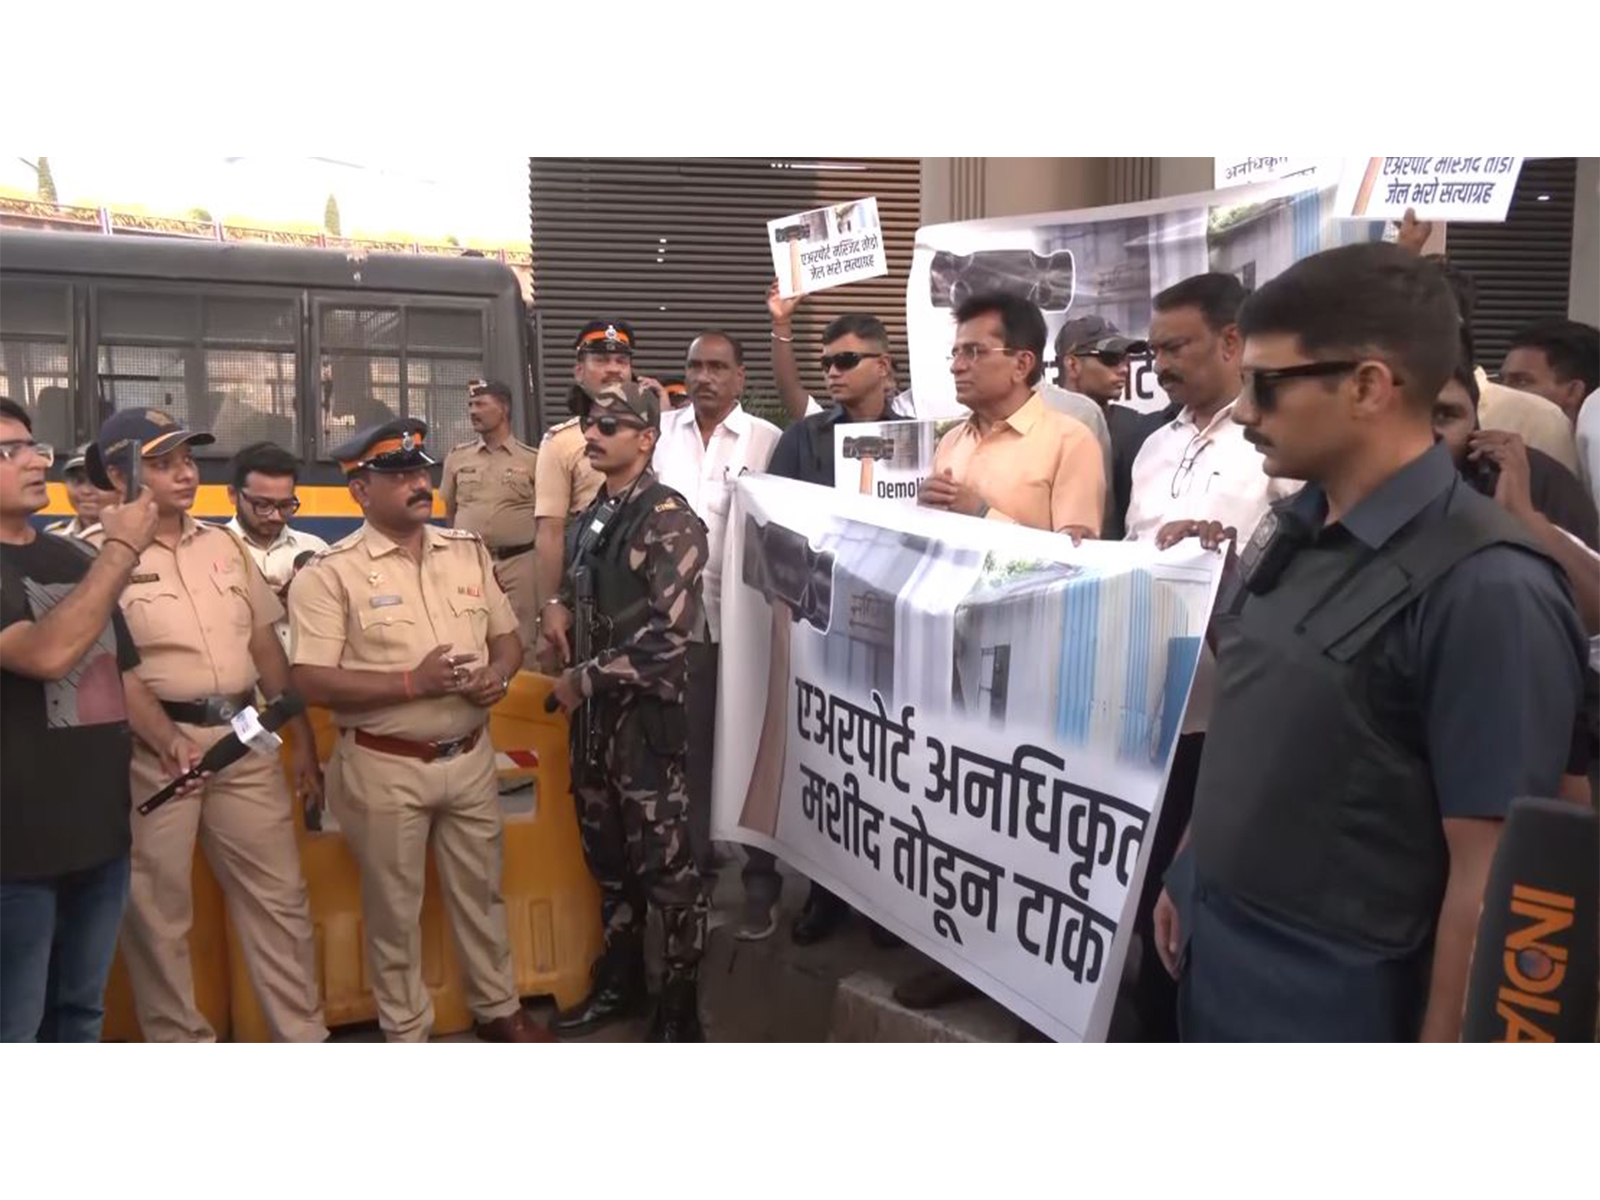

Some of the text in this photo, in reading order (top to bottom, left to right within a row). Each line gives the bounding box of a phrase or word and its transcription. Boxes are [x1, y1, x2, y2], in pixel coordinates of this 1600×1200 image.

[1385, 177, 1496, 205] जेल भरो सत्याग्रह
[809, 254, 875, 280] जेल भरो सत्याग्रह
[877, 477, 923, 499] Demol
[795, 677, 1151, 900] एअरपोर्ट अनधिकृत
[799, 764, 1118, 985] मशीद तोडून टाक
